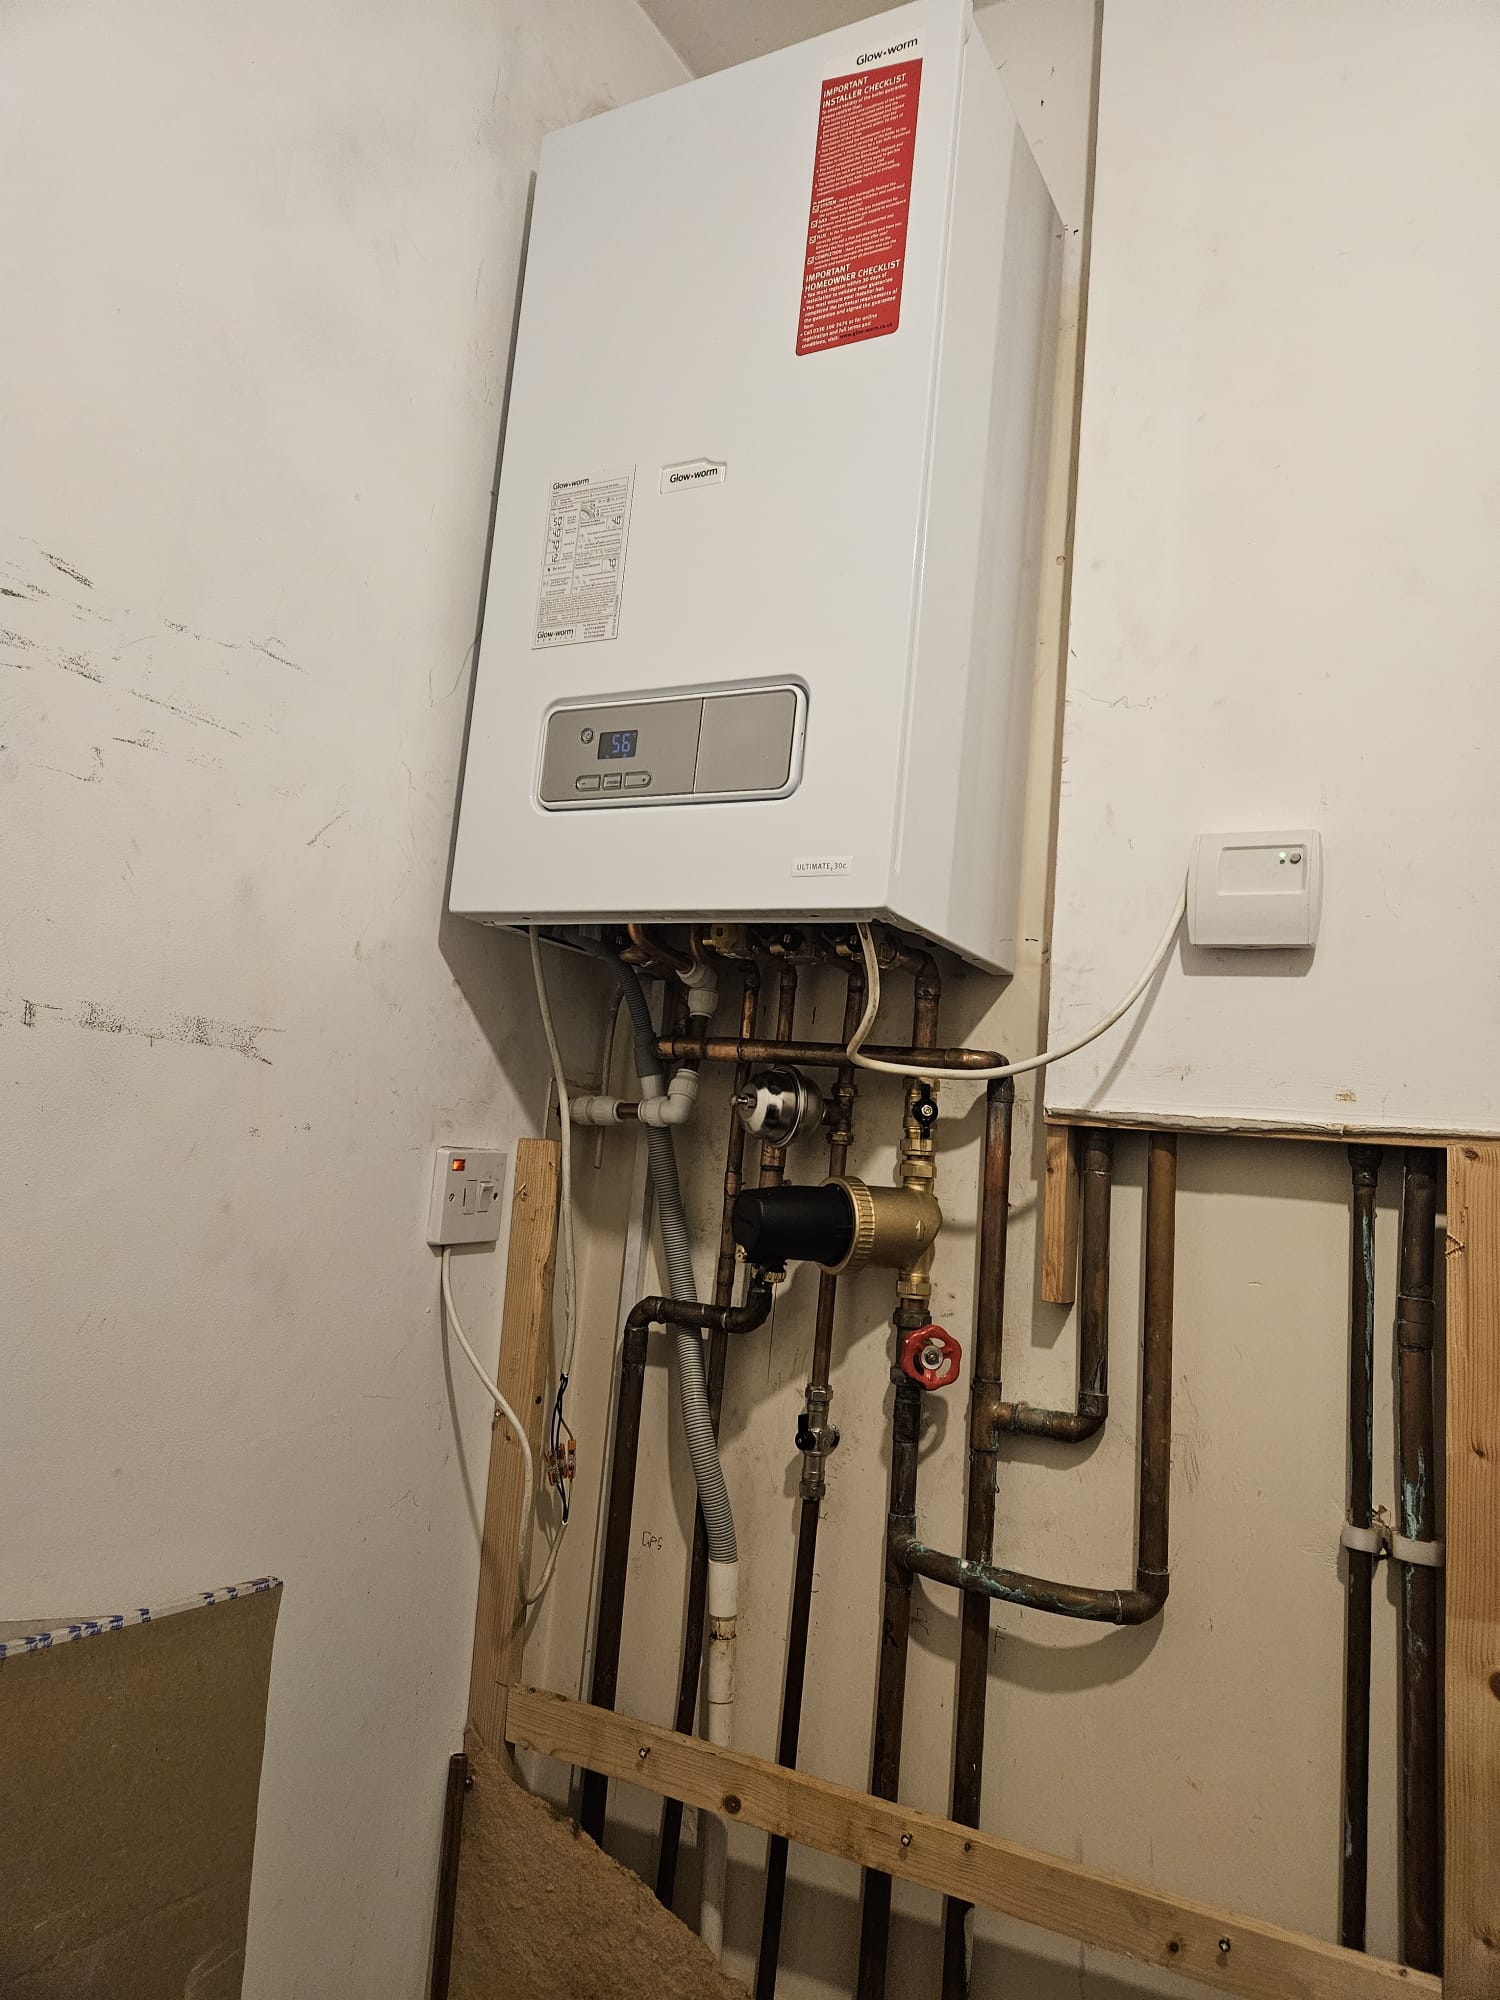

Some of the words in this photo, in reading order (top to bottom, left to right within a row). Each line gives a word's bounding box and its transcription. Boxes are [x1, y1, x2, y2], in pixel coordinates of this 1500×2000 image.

[823, 89, 862, 108] INSTALLER
[864, 73, 905, 93] CHECKLIST
[824, 77, 867, 97] IMPORTANT
[805, 272, 855, 291] HOMEOWNER
[858, 259, 900, 277] CHECKLIST
[806, 264, 850, 282] IMPORTANT
[869, 278, 892, 288] guarantee
